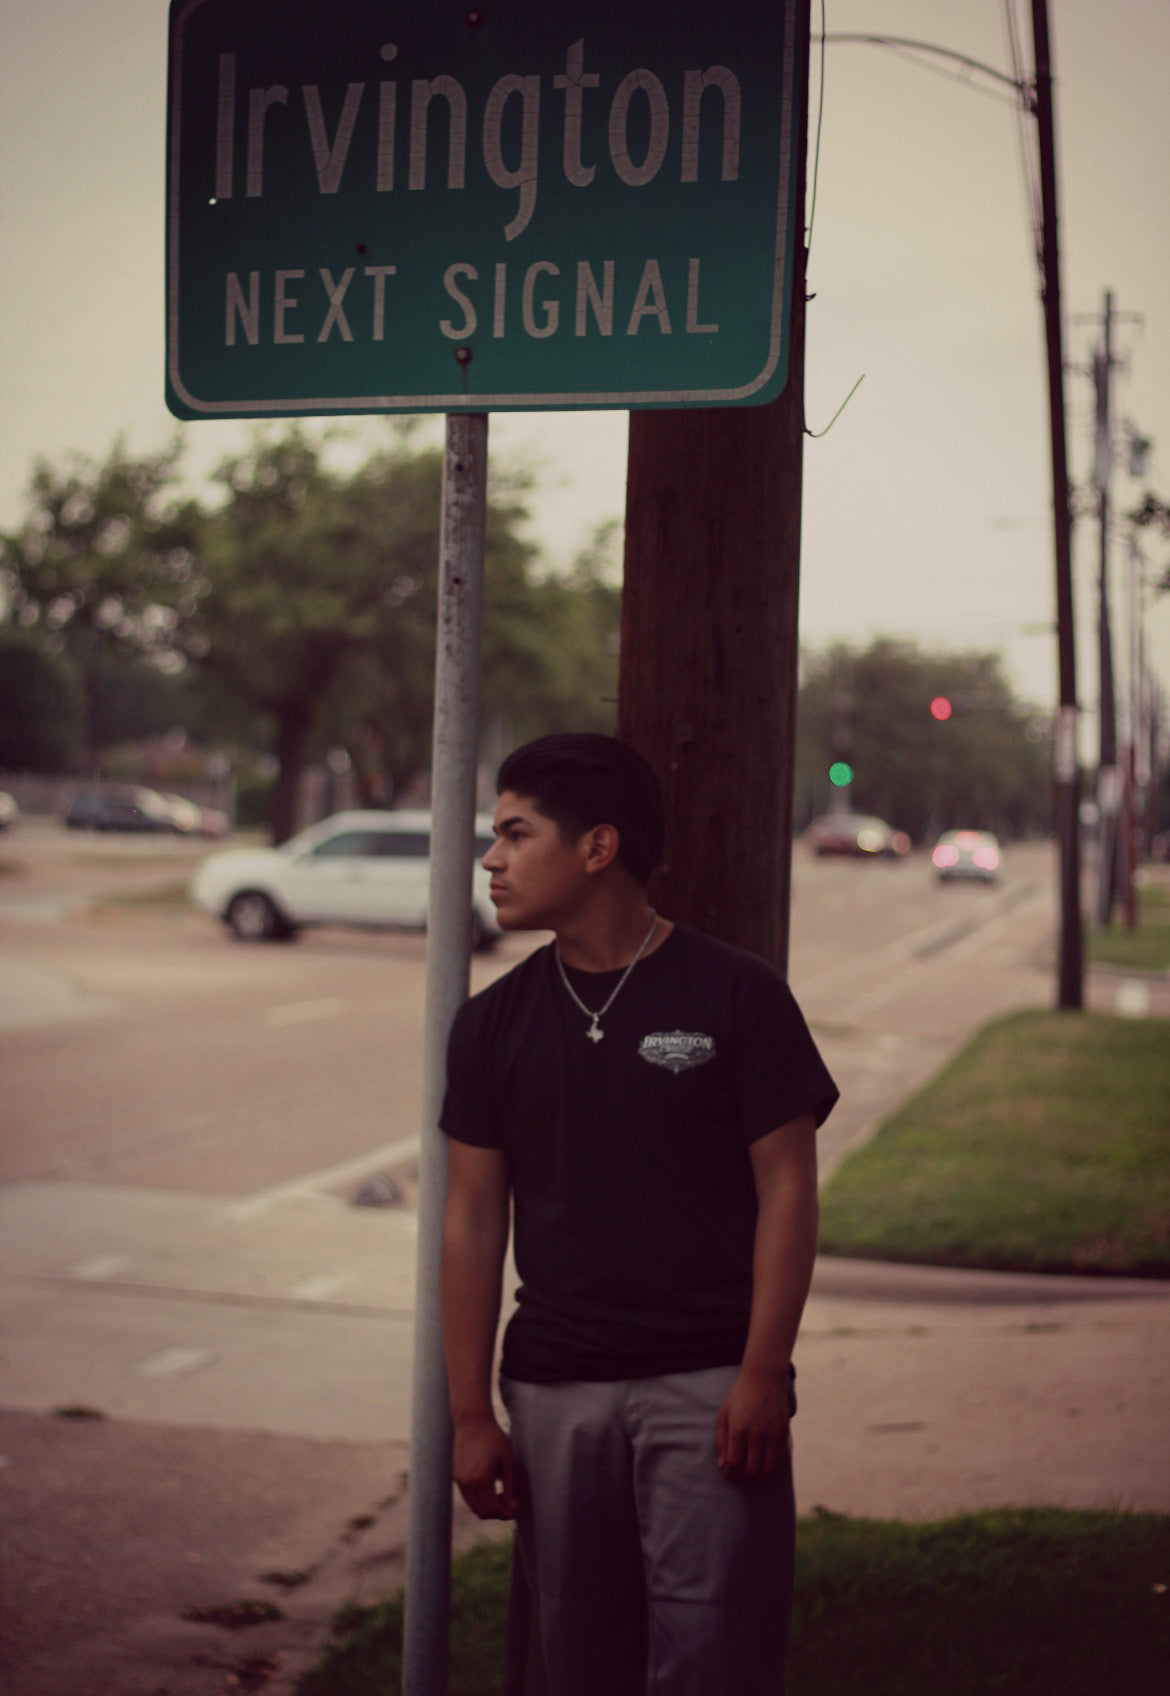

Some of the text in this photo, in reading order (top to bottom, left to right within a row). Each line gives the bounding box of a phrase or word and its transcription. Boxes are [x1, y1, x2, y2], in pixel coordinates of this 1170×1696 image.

[215, 39, 742, 241] Irvington
[224, 257, 719, 346] NEXT SIGNAL
[642, 1034, 713, 1050] IRVINGTON
